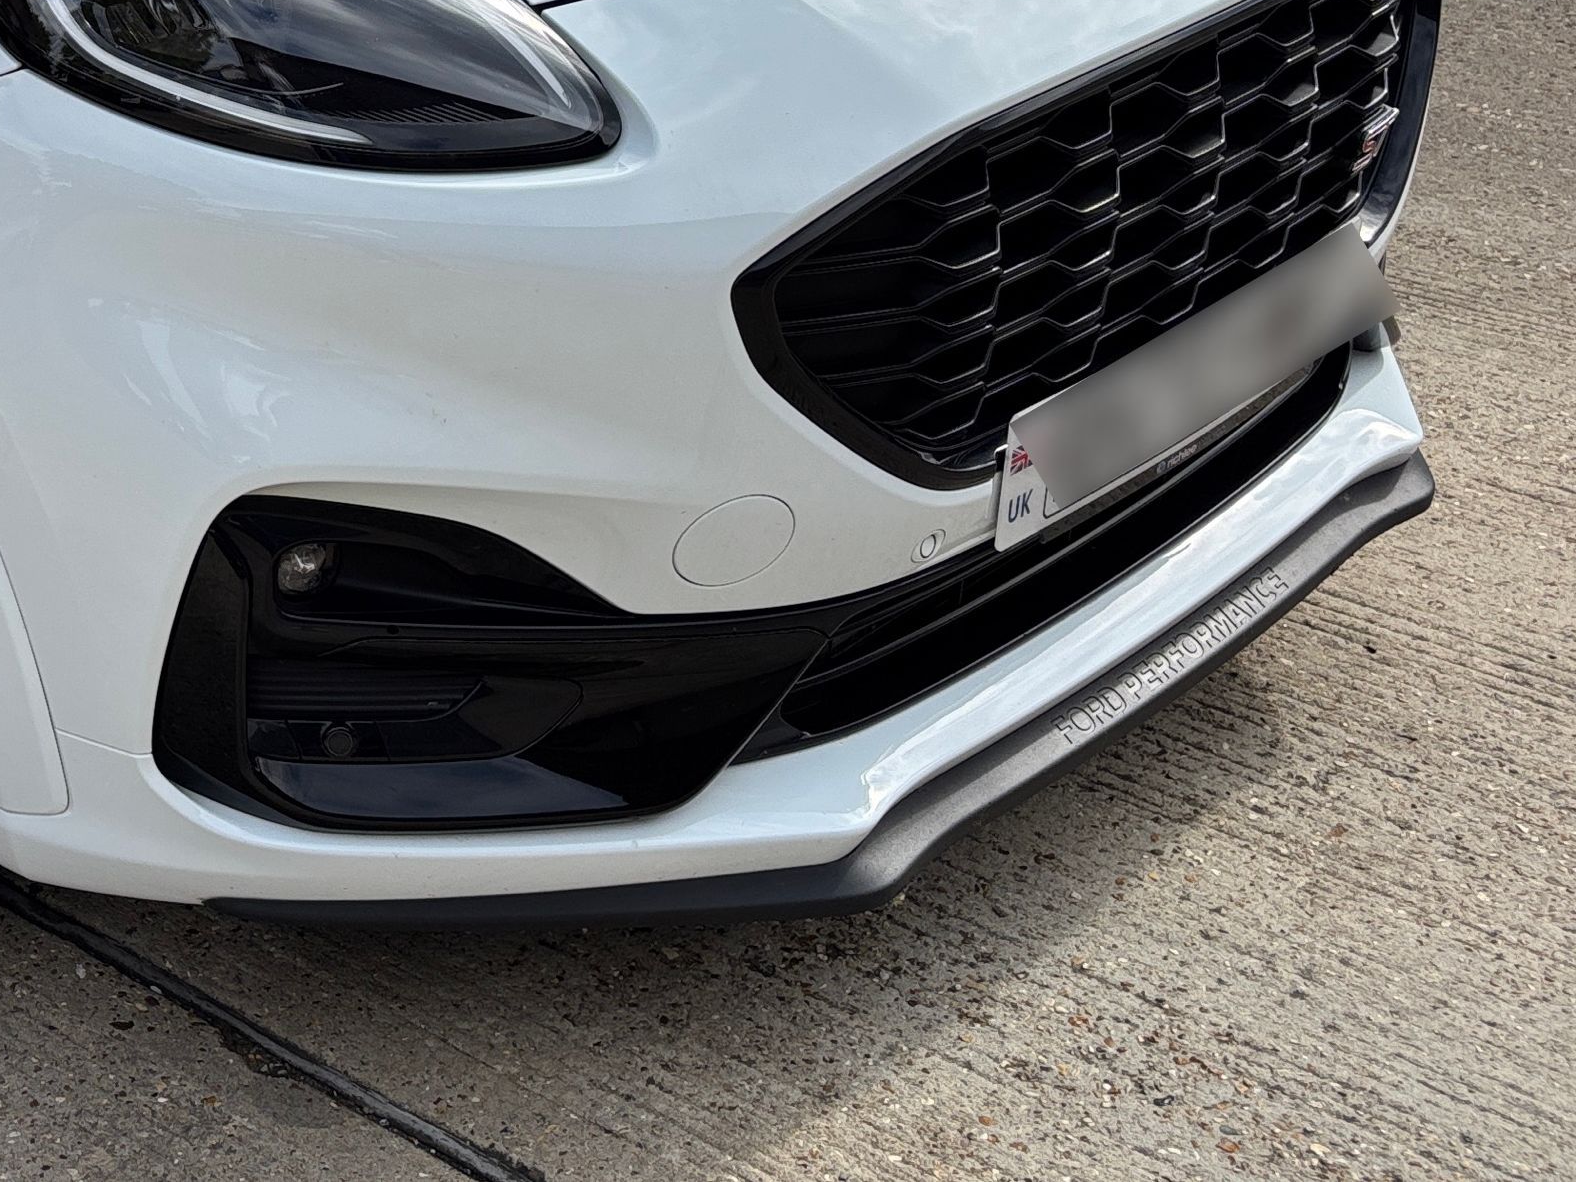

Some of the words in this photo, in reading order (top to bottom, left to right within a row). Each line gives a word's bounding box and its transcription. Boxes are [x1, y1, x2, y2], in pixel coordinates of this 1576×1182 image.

[1008, 488, 1034, 524] UK
[1051, 685, 1127, 745] FORD
[1123, 566, 1290, 701] PERFORMANCE
